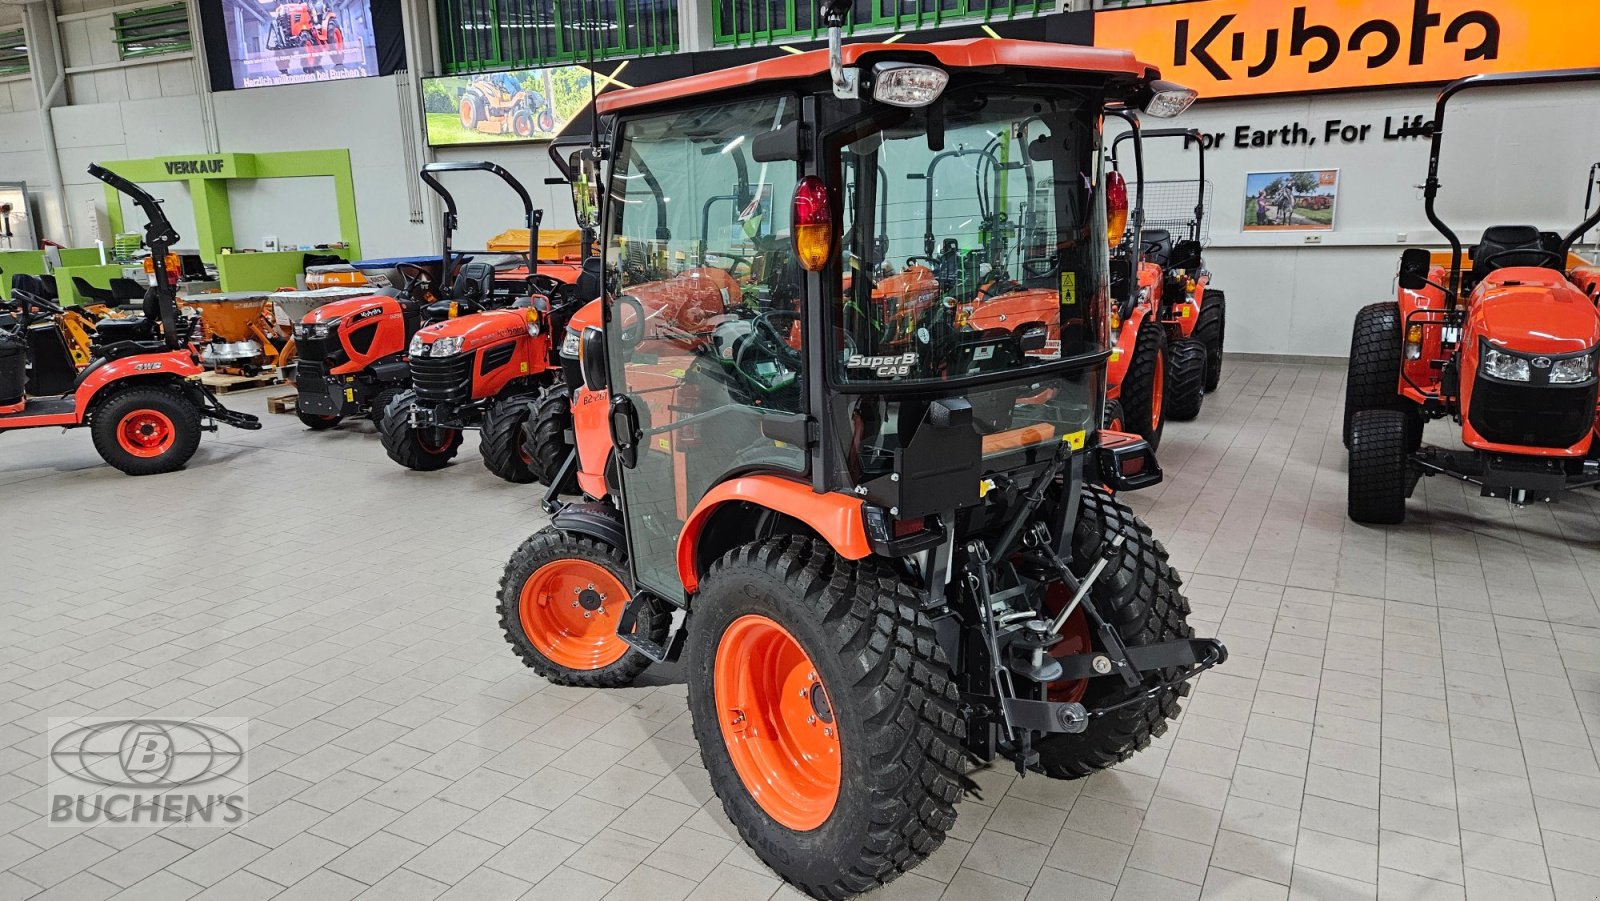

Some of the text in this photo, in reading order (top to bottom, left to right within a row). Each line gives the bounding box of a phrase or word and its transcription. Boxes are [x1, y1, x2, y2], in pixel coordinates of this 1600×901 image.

[1174, 0, 1500, 81] Kubota
[243, 75, 273, 88] Herzlich
[273, 72, 316, 85] willkommen
[316, 70, 329, 81] bei
[1234, 122, 1316, 148] Earth,
[1324, 119, 1372, 143] For
[164, 159, 224, 175] VERKAUF
[135, 362, 162, 370] 4WD
[877, 366, 910, 376] CAB
